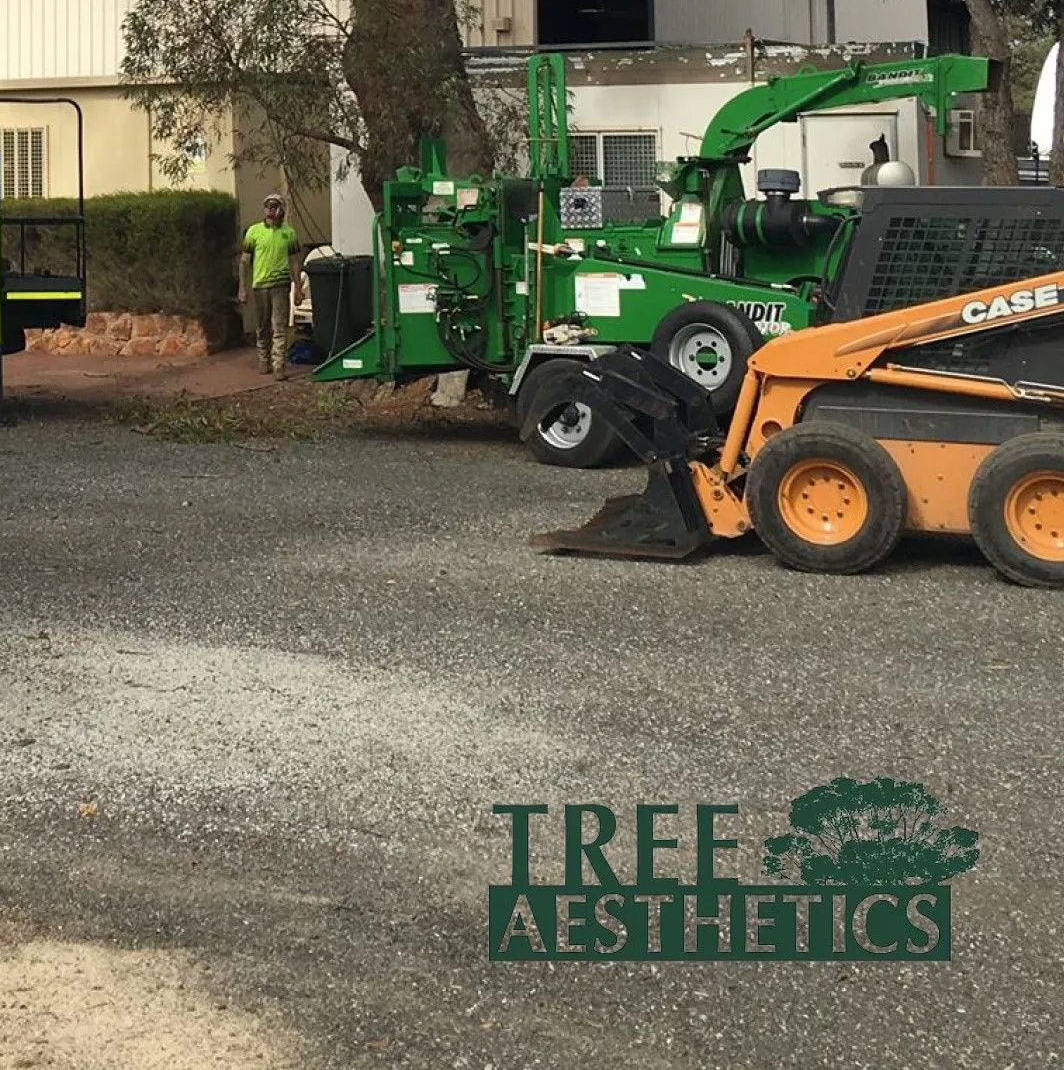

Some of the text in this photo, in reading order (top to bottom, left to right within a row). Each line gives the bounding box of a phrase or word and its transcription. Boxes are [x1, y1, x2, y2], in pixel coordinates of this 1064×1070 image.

[866, 69, 921, 83] BANDIT
[728, 301, 786, 321] NDIT
[962, 284, 1058, 323] CASE
